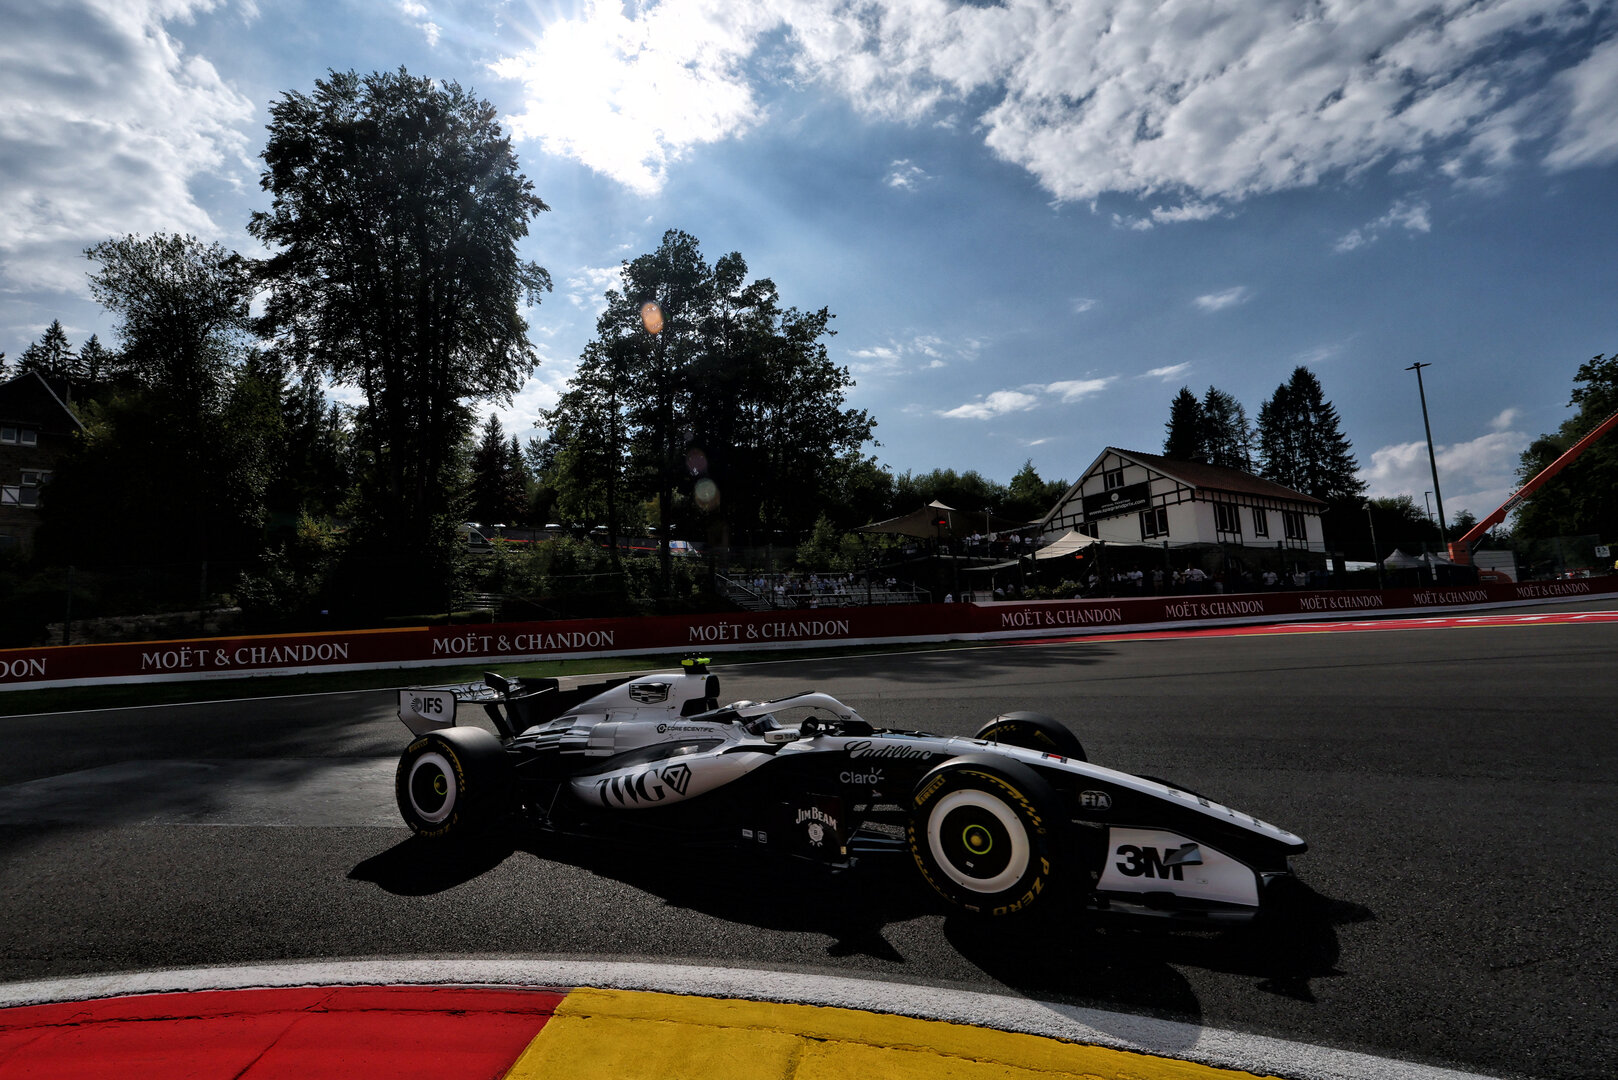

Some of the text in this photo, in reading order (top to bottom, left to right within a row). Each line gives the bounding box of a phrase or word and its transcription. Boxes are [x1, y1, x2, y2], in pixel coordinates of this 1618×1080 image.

[1412, 590, 1488, 605] MOËT & CHANDON
[1516, 582, 1590, 598] MOËT & CHANDON
[1165, 600, 1264, 618] MOËT & CHANDON
[1300, 594, 1384, 610] MOËT & CHANDON
[1001, 608, 1122, 627] MOËT & CHANDON
[689, 619, 850, 641] MOËT & CHANDON
[432, 630, 615, 655] MOËT & CHANDON
[141, 642, 350, 670] MOËT & CHANDON
[423, 697, 443, 713] IFS
[844, 740, 932, 760] Cadillac
[839, 770, 879, 785] Claro
[914, 773, 947, 806] PIRELLI
[1080, 792, 1110, 809] FIA
[795, 806, 838, 831] JIM BEAM
[1116, 844, 1185, 881] 3M
[992, 856, 1050, 917] P ZERO
